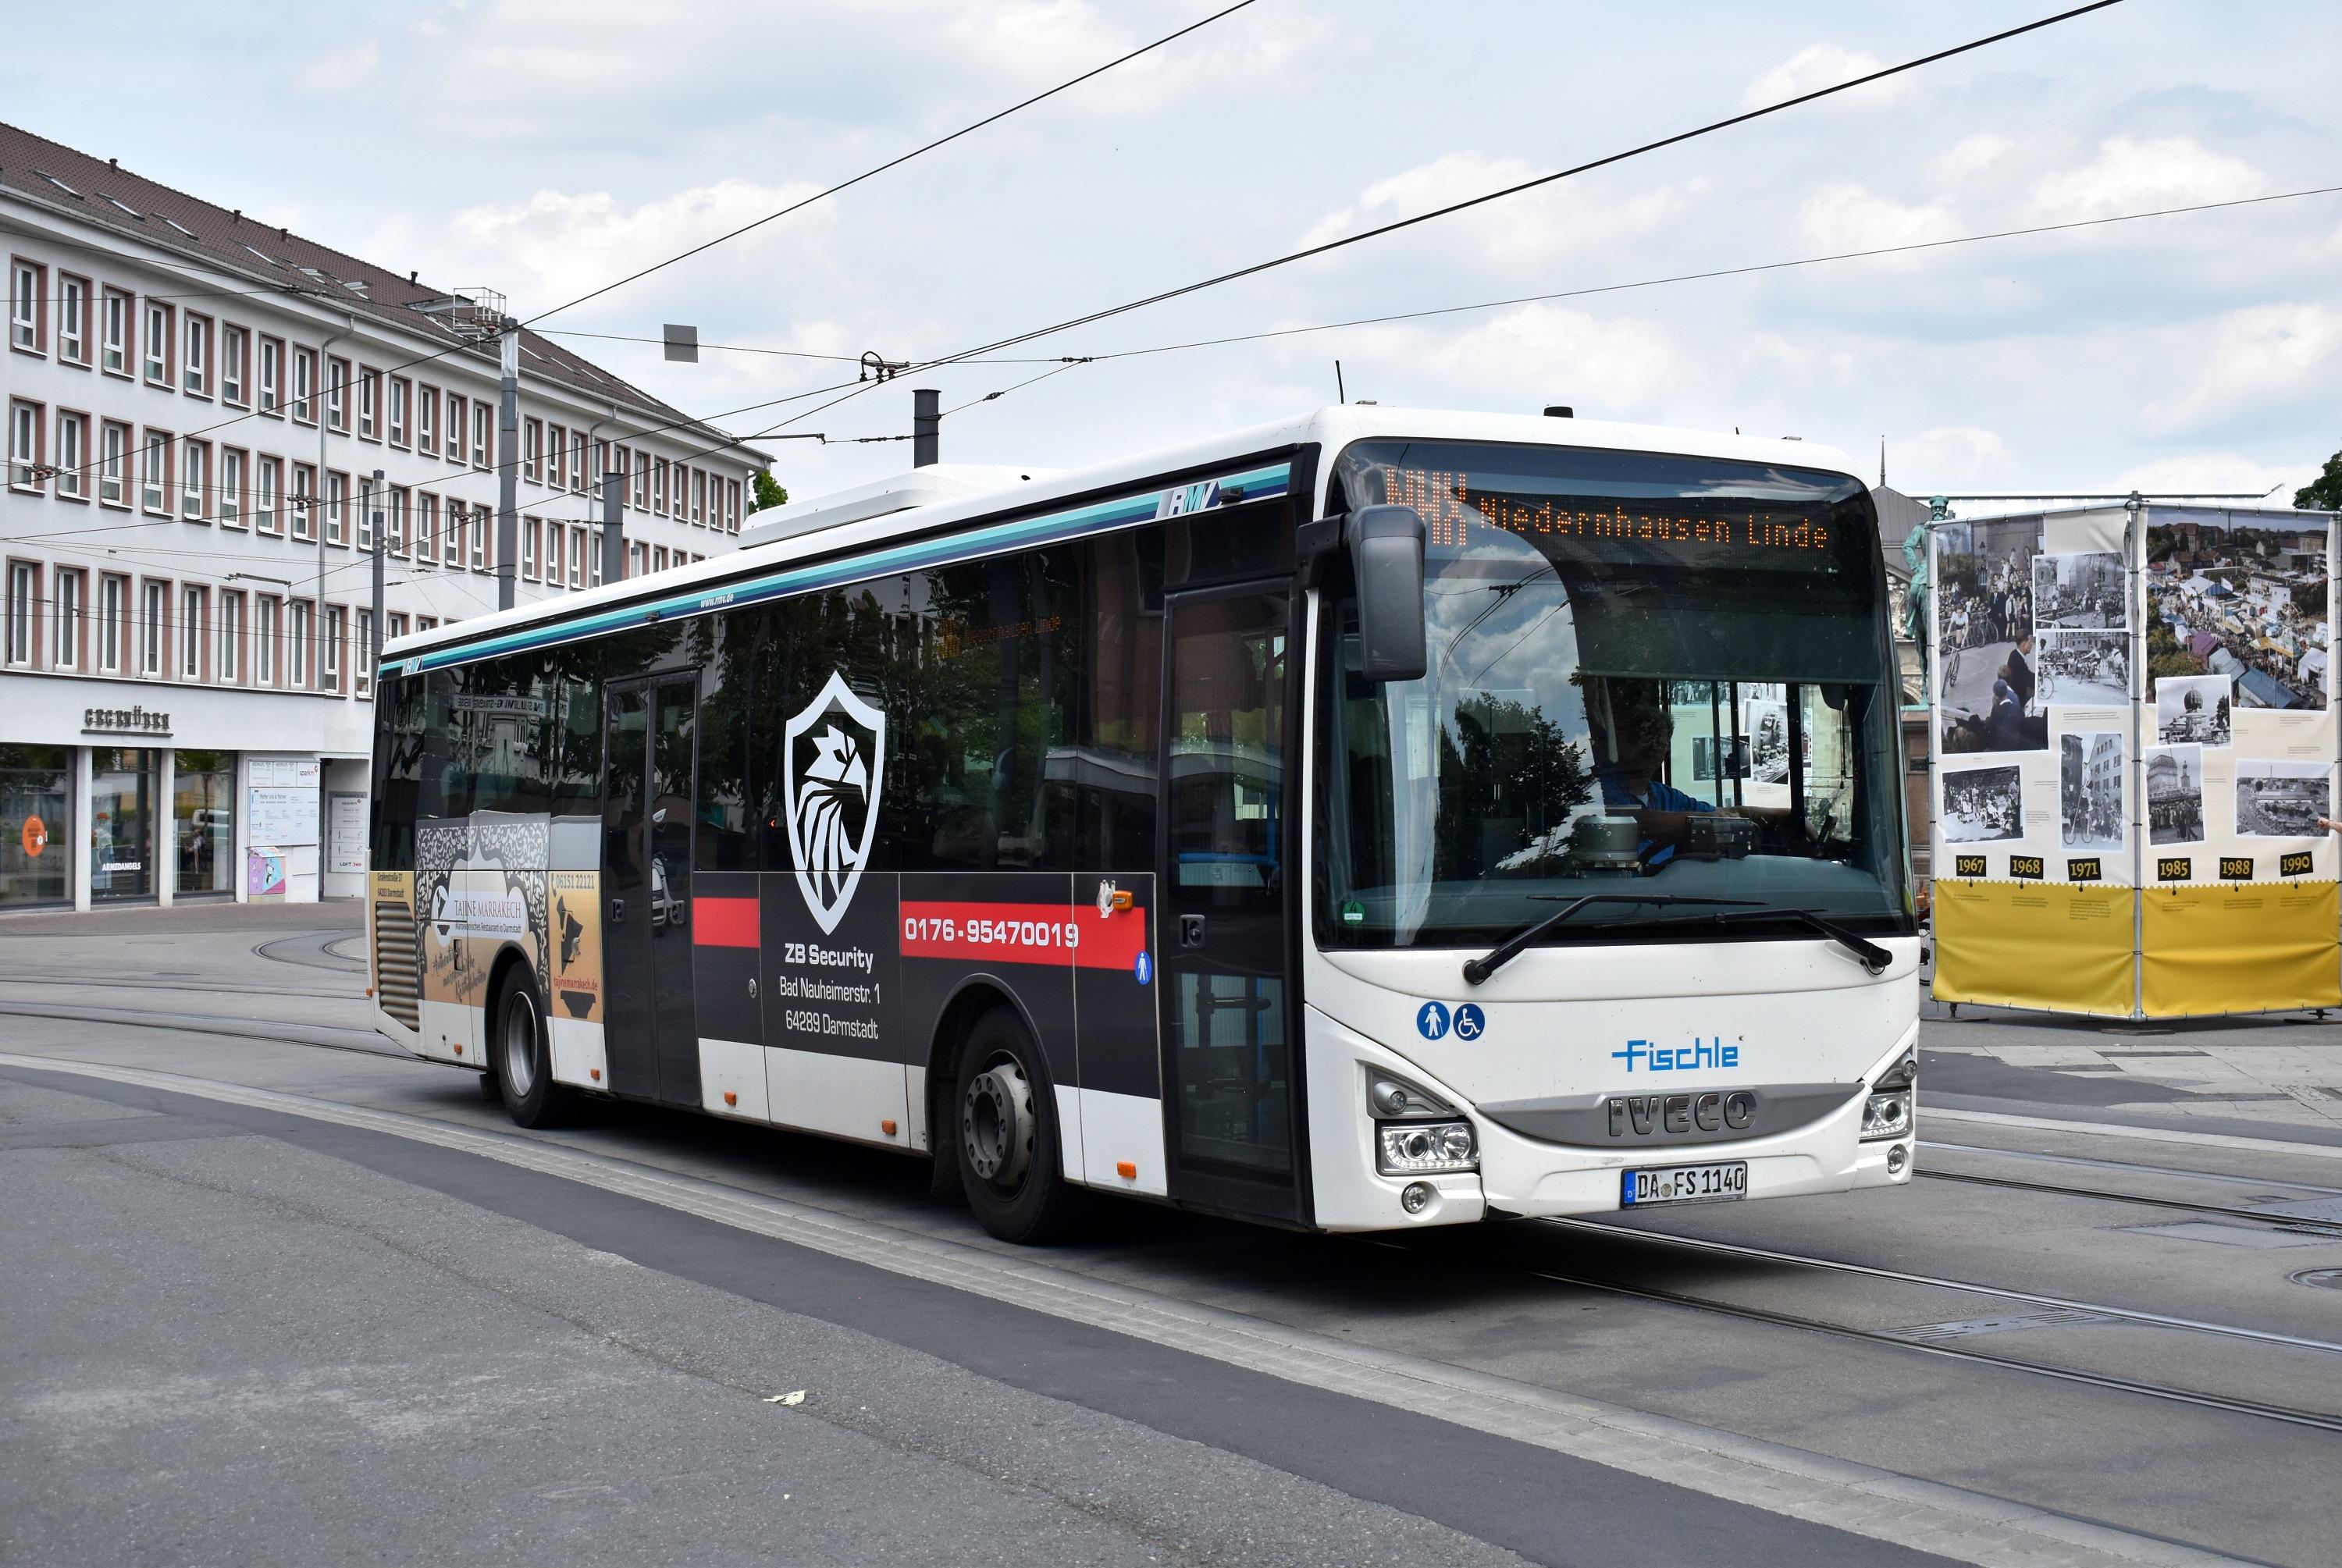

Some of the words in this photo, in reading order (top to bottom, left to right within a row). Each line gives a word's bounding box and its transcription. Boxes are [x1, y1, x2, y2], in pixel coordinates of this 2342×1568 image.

[1168, 481, 1217, 516] RMV
[1481, 497, 1730, 543] Niedernhausen
[1748, 514, 1828, 548] Linde
[700, 593, 734, 609] www.rmv.de
[102, 862, 141, 871] ARMEDANGELS
[1958, 858, 1984, 873] 1967
[2012, 859, 2041, 874] 1968
[2070, 862, 2098, 877] 1971
[2160, 860, 2188, 876] 1985
[2222, 860, 2250, 875] 1988
[2283, 855, 2310, 871] 1990
[556, 874, 575, 889] 06151
[576, 874, 594, 889] 22121
[387, 889, 404, 898] Darmstadt
[454, 901, 476, 919] TAJINE
[477, 901, 521, 919] MARRAKECH
[1350, 901, 1357, 913] 4
[503, 924, 521, 933] Darmstadt
[905, 918, 1080, 948] 0176-95470019
[785, 943, 807, 964] ZB
[809, 944, 874, 974] Security
[553, 976, 598, 990] tajinemarrakech.de
[780, 976, 799, 997] Bad
[800, 978, 871, 1004] Nauheimerstr.
[874, 983, 880, 1004] 1
[785, 1010, 820, 1033] 64289
[823, 1012, 879, 1040] Darmstadt
[1611, 1036, 1738, 1072] Fischle
[1609, 1091, 1756, 1137] IVECO
[1637, 1173, 1660, 1199] DA
[1674, 1172, 1696, 1196] FS
[1702, 1168, 1744, 1194] 1140
[1628, 1190, 1633, 1199] D
